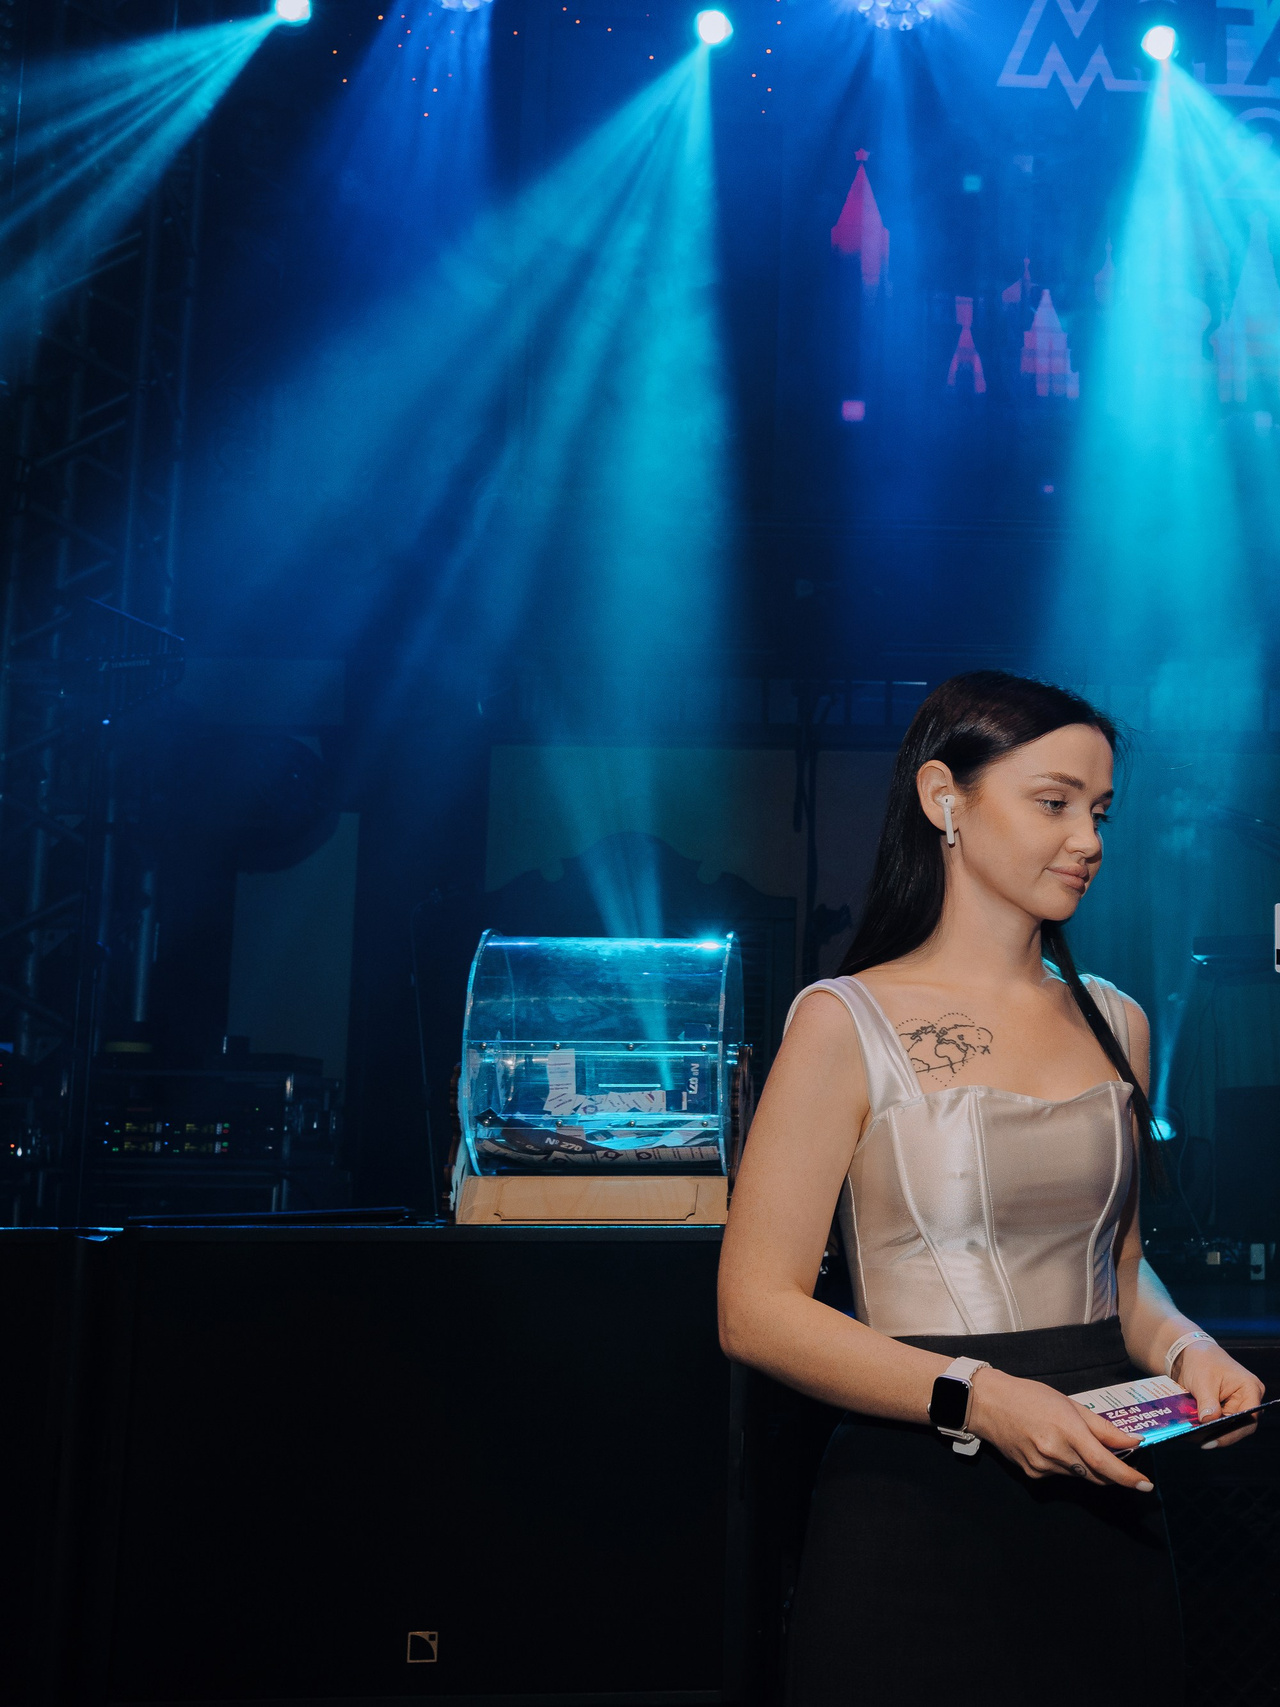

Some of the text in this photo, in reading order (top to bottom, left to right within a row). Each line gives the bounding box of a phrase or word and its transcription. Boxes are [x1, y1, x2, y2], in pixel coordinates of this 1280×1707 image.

[545, 1137, 583, 1152] № 270
[1106, 1406, 1142, 1419] № 572
[1120, 1418, 1159, 1433] КАРТА
